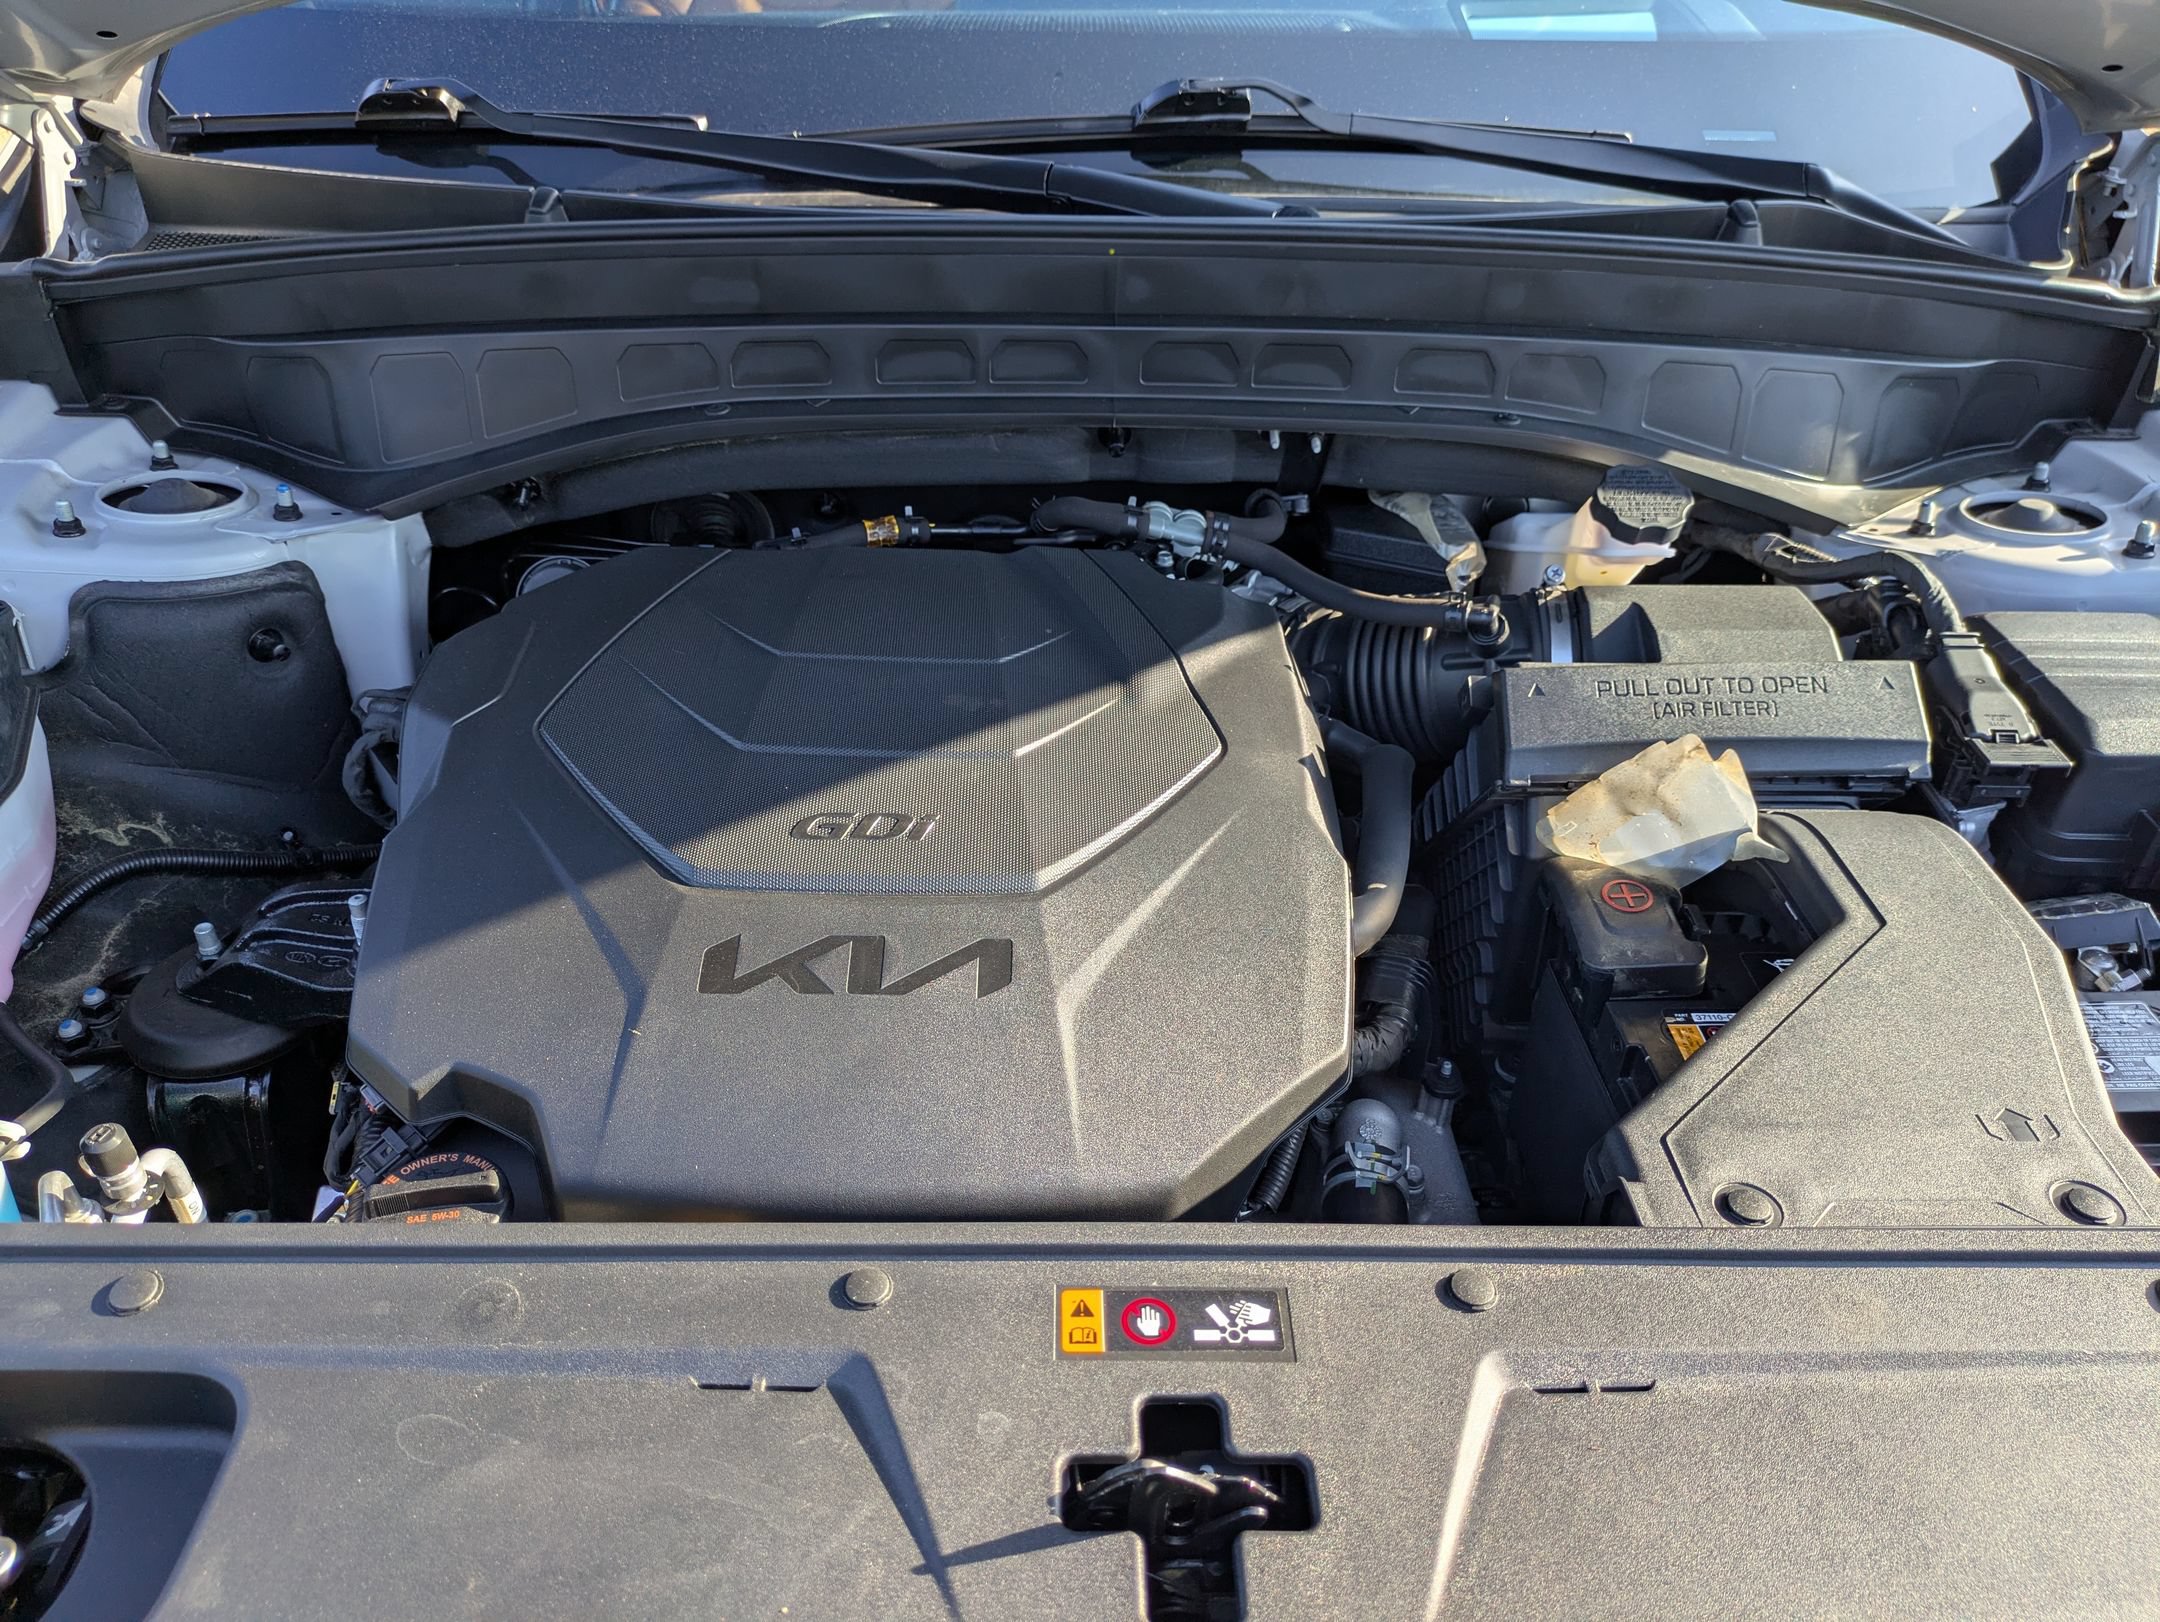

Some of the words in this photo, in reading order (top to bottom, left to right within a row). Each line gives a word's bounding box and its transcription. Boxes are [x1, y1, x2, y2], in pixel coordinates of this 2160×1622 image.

[1595, 678, 1659, 698] PULL
[1664, 677, 1714, 696] OUT
[1720, 676, 1754, 695] TO
[1761, 675, 1828, 695] OPEN
[790, 812, 940, 841] GDi
[696, 933, 1013, 999] KIA
[400, 1153, 459, 1175] OWNER'S
[463, 1154, 497, 1171] MANU
[406, 1214, 427, 1225] SAE
[431, 1210, 460, 1221] 5W-30
